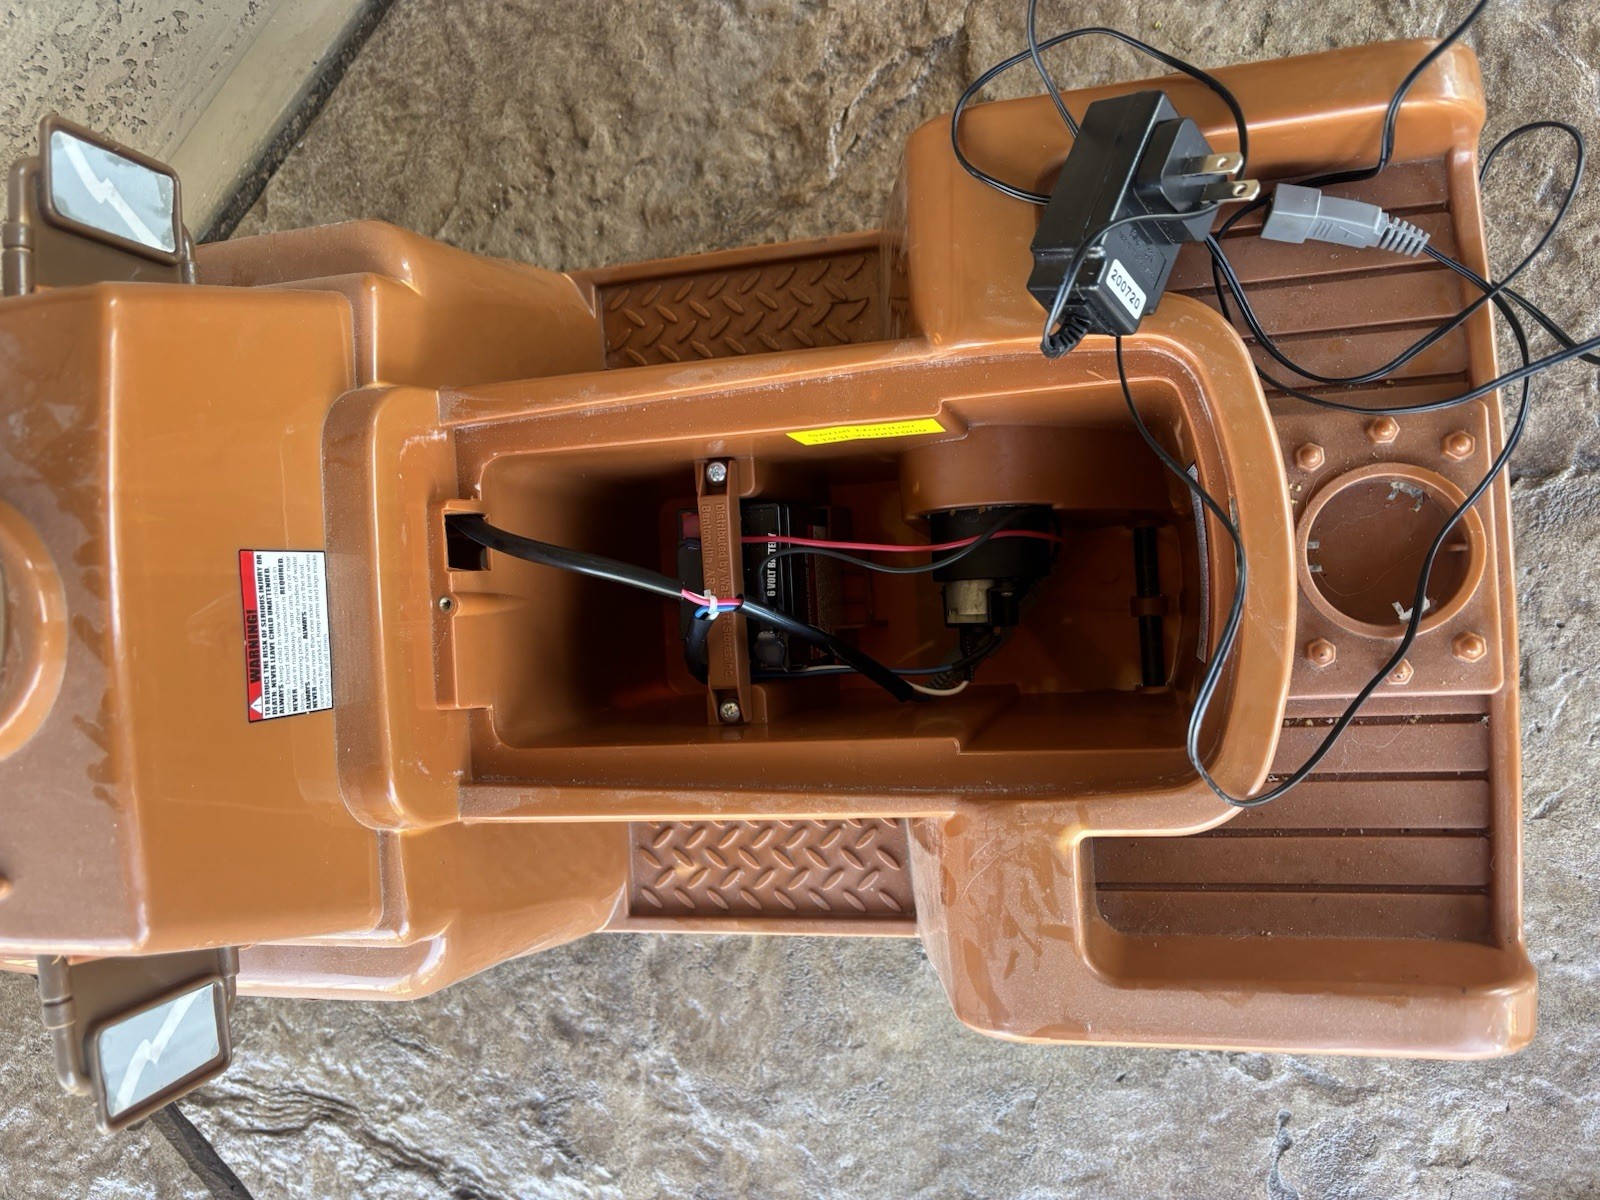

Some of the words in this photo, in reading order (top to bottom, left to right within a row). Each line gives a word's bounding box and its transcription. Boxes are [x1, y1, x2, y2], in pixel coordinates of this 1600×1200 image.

[1110, 268, 1141, 310] 200720
[701, 505, 715, 567] Bentonville,
[715, 503, 729, 559] Distributed
[256, 555, 262, 565] OR
[716, 560, 729, 574] by
[277, 557, 285, 595] REQUIRED.
[287, 583, 292, 592] on
[704, 569, 715, 586] AR
[766, 569, 776, 590] VOLT
[258, 595, 266, 628] SERIOUS
[281, 604, 289, 644] supervision
[245, 610, 260, 684] WARNING!
[260, 630, 266, 638] OF
[264, 707, 270, 716] TO
[277, 685, 285, 715] ALWAYS
